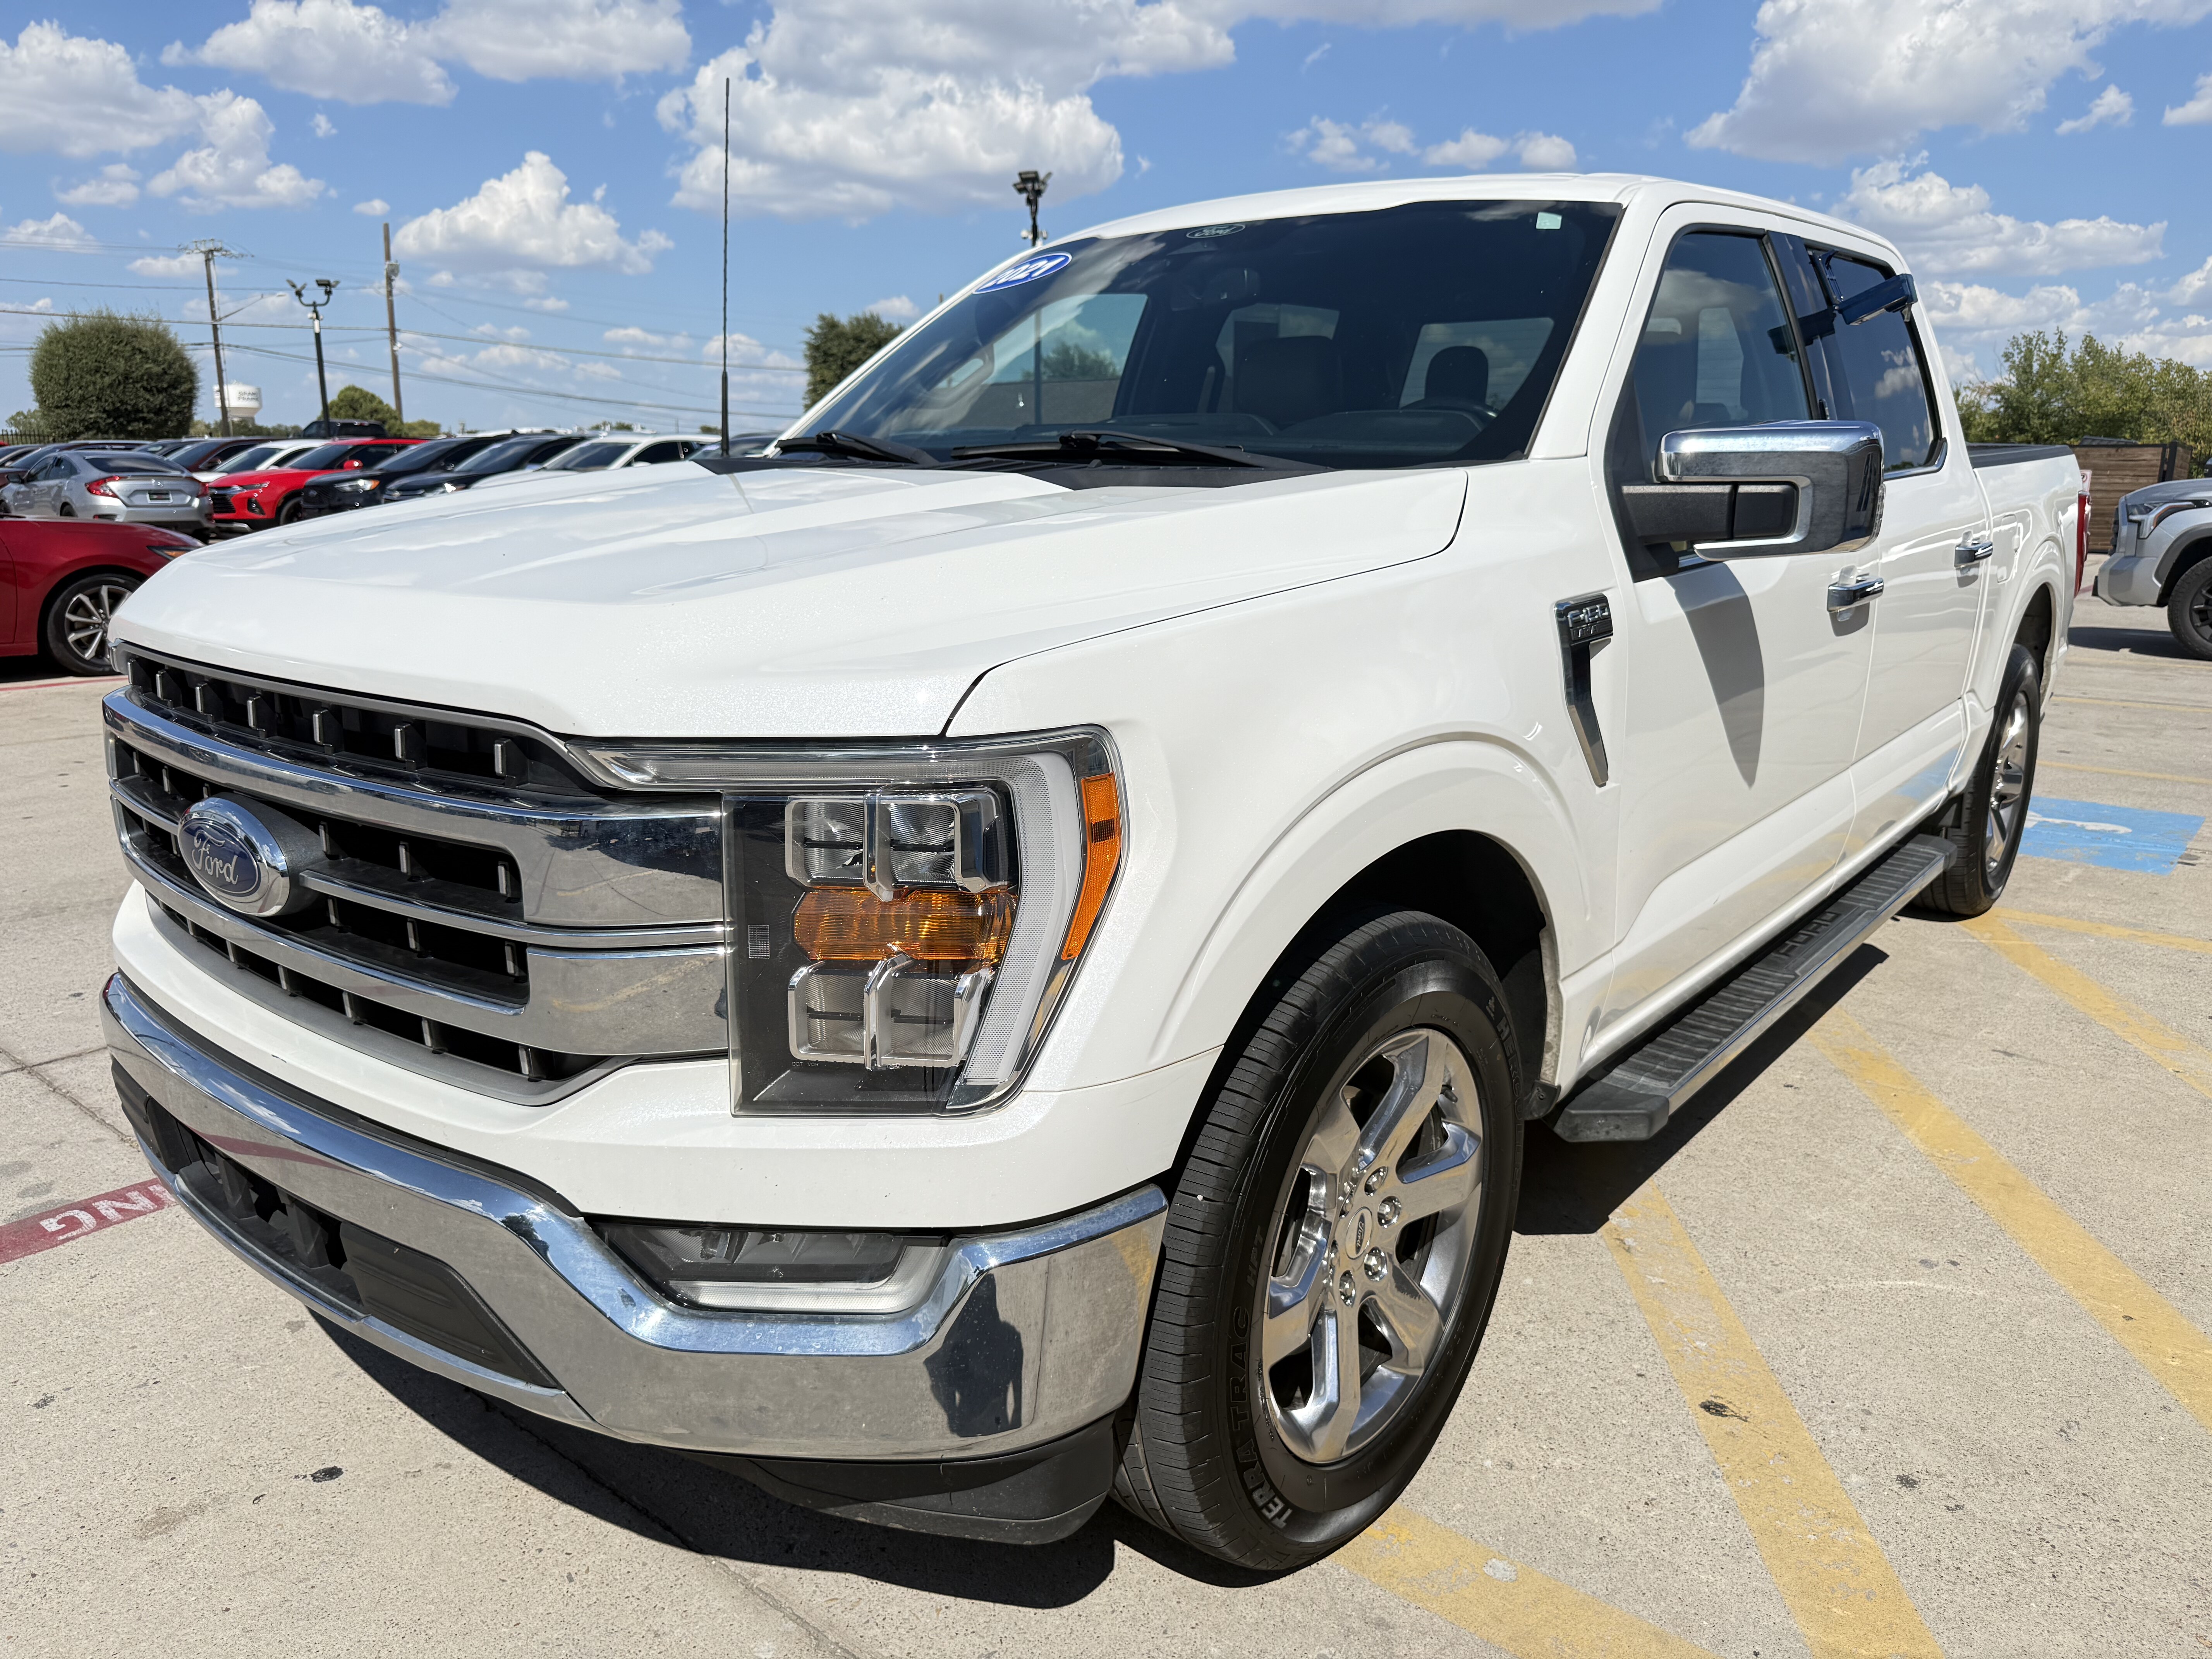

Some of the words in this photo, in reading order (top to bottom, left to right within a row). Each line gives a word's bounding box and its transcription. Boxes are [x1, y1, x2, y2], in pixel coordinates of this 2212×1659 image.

[978, 257, 1066, 290] 2021
[192, 829, 239, 885] Ford
[1246, 1225, 1263, 1288] HPT
[1356, 1221, 1364, 1248] Ford
[1230, 1306, 1249, 1431] TRAC
[1236, 1438, 1293, 1528] TERRA
